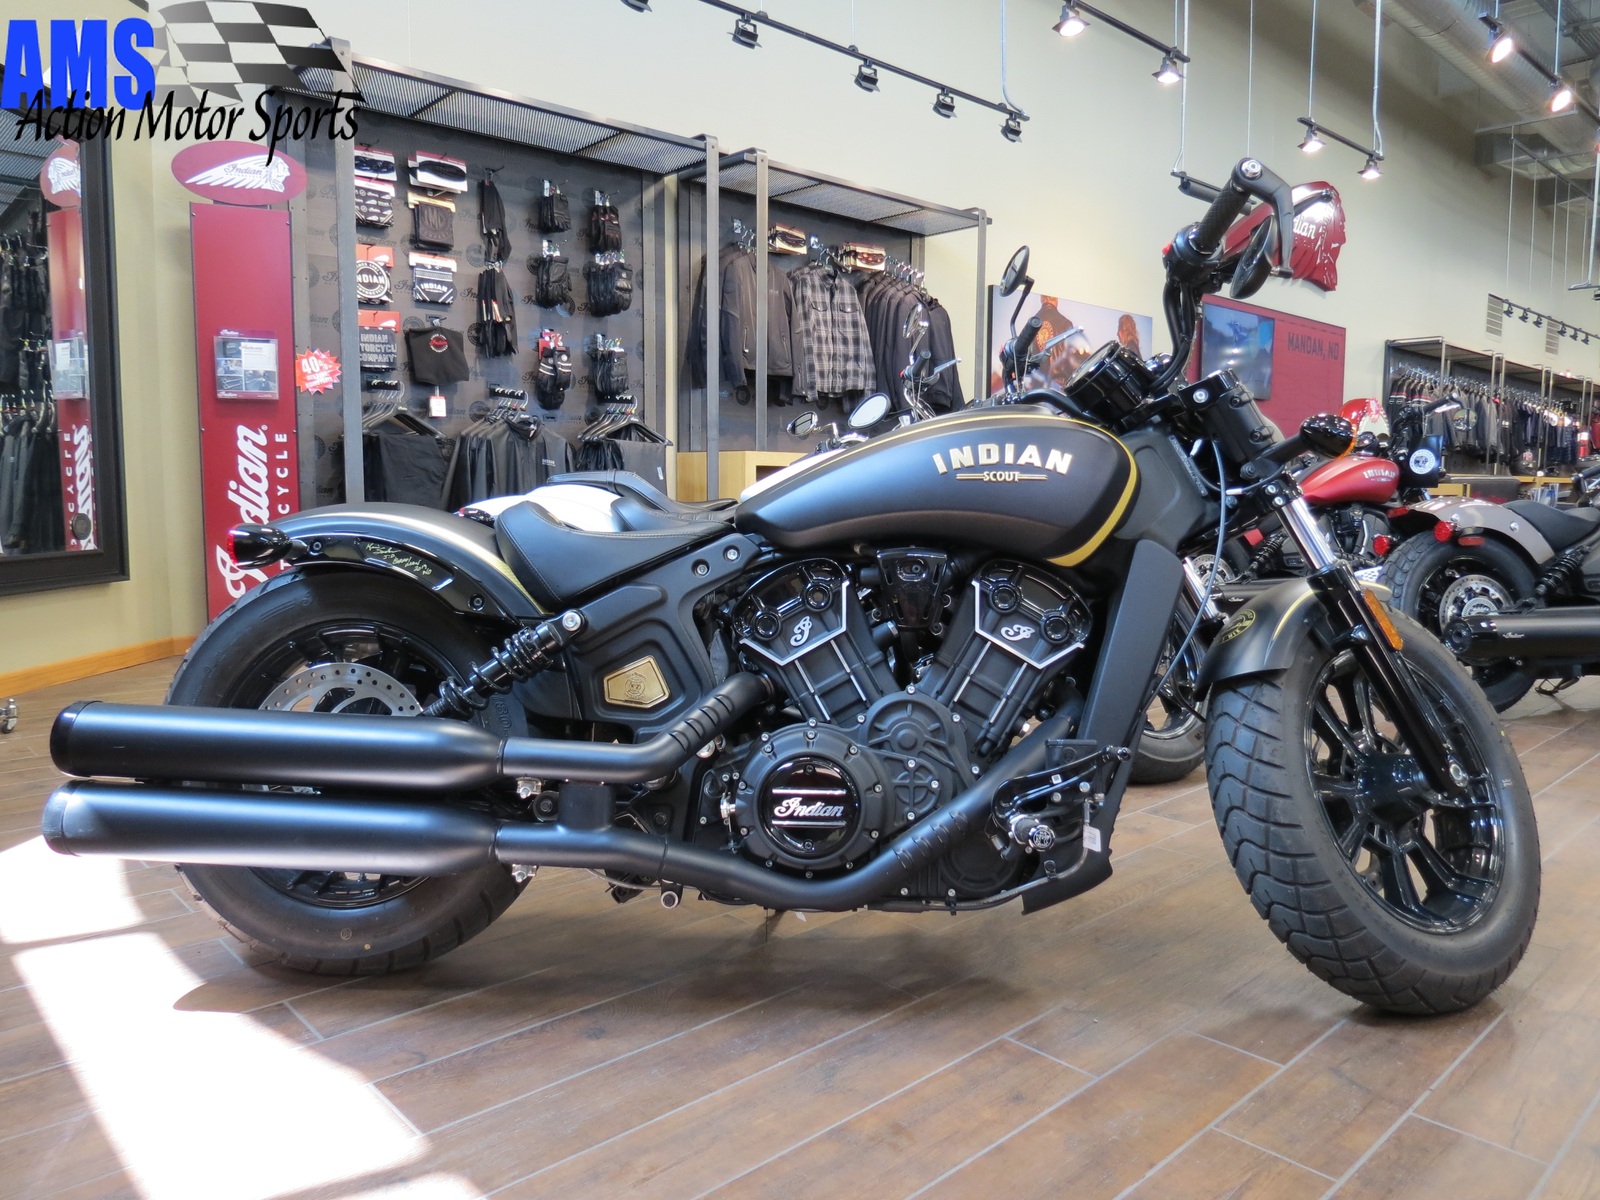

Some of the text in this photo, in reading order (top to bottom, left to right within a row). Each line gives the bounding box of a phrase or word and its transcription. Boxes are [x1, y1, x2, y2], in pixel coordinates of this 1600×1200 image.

[224, 163, 263, 175] Indian
[356, 274, 385, 284] NDIAN
[1328, 341, 1339, 360] ND
[932, 443, 1073, 475] INDIAN
[983, 471, 1020, 482] SCOUT
[774, 797, 844, 817] Indian
